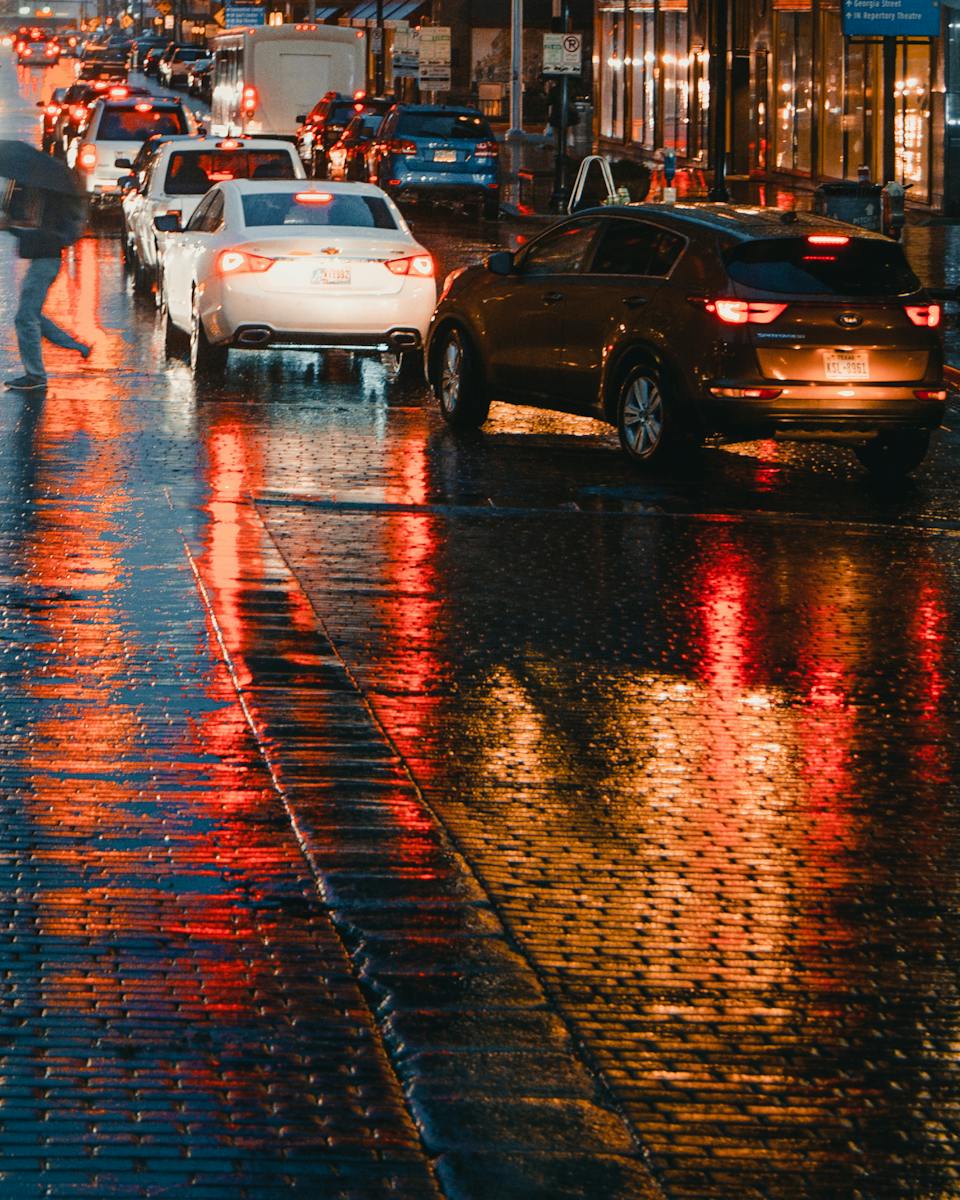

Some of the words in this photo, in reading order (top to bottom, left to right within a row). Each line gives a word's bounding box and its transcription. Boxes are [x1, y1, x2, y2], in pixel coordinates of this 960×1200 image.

[853, 0, 880, 8] Georgia
[881, 0, 902, 7] Street
[863, 12, 895, 21] Repertory
[897, 12, 922, 20] Theatre
